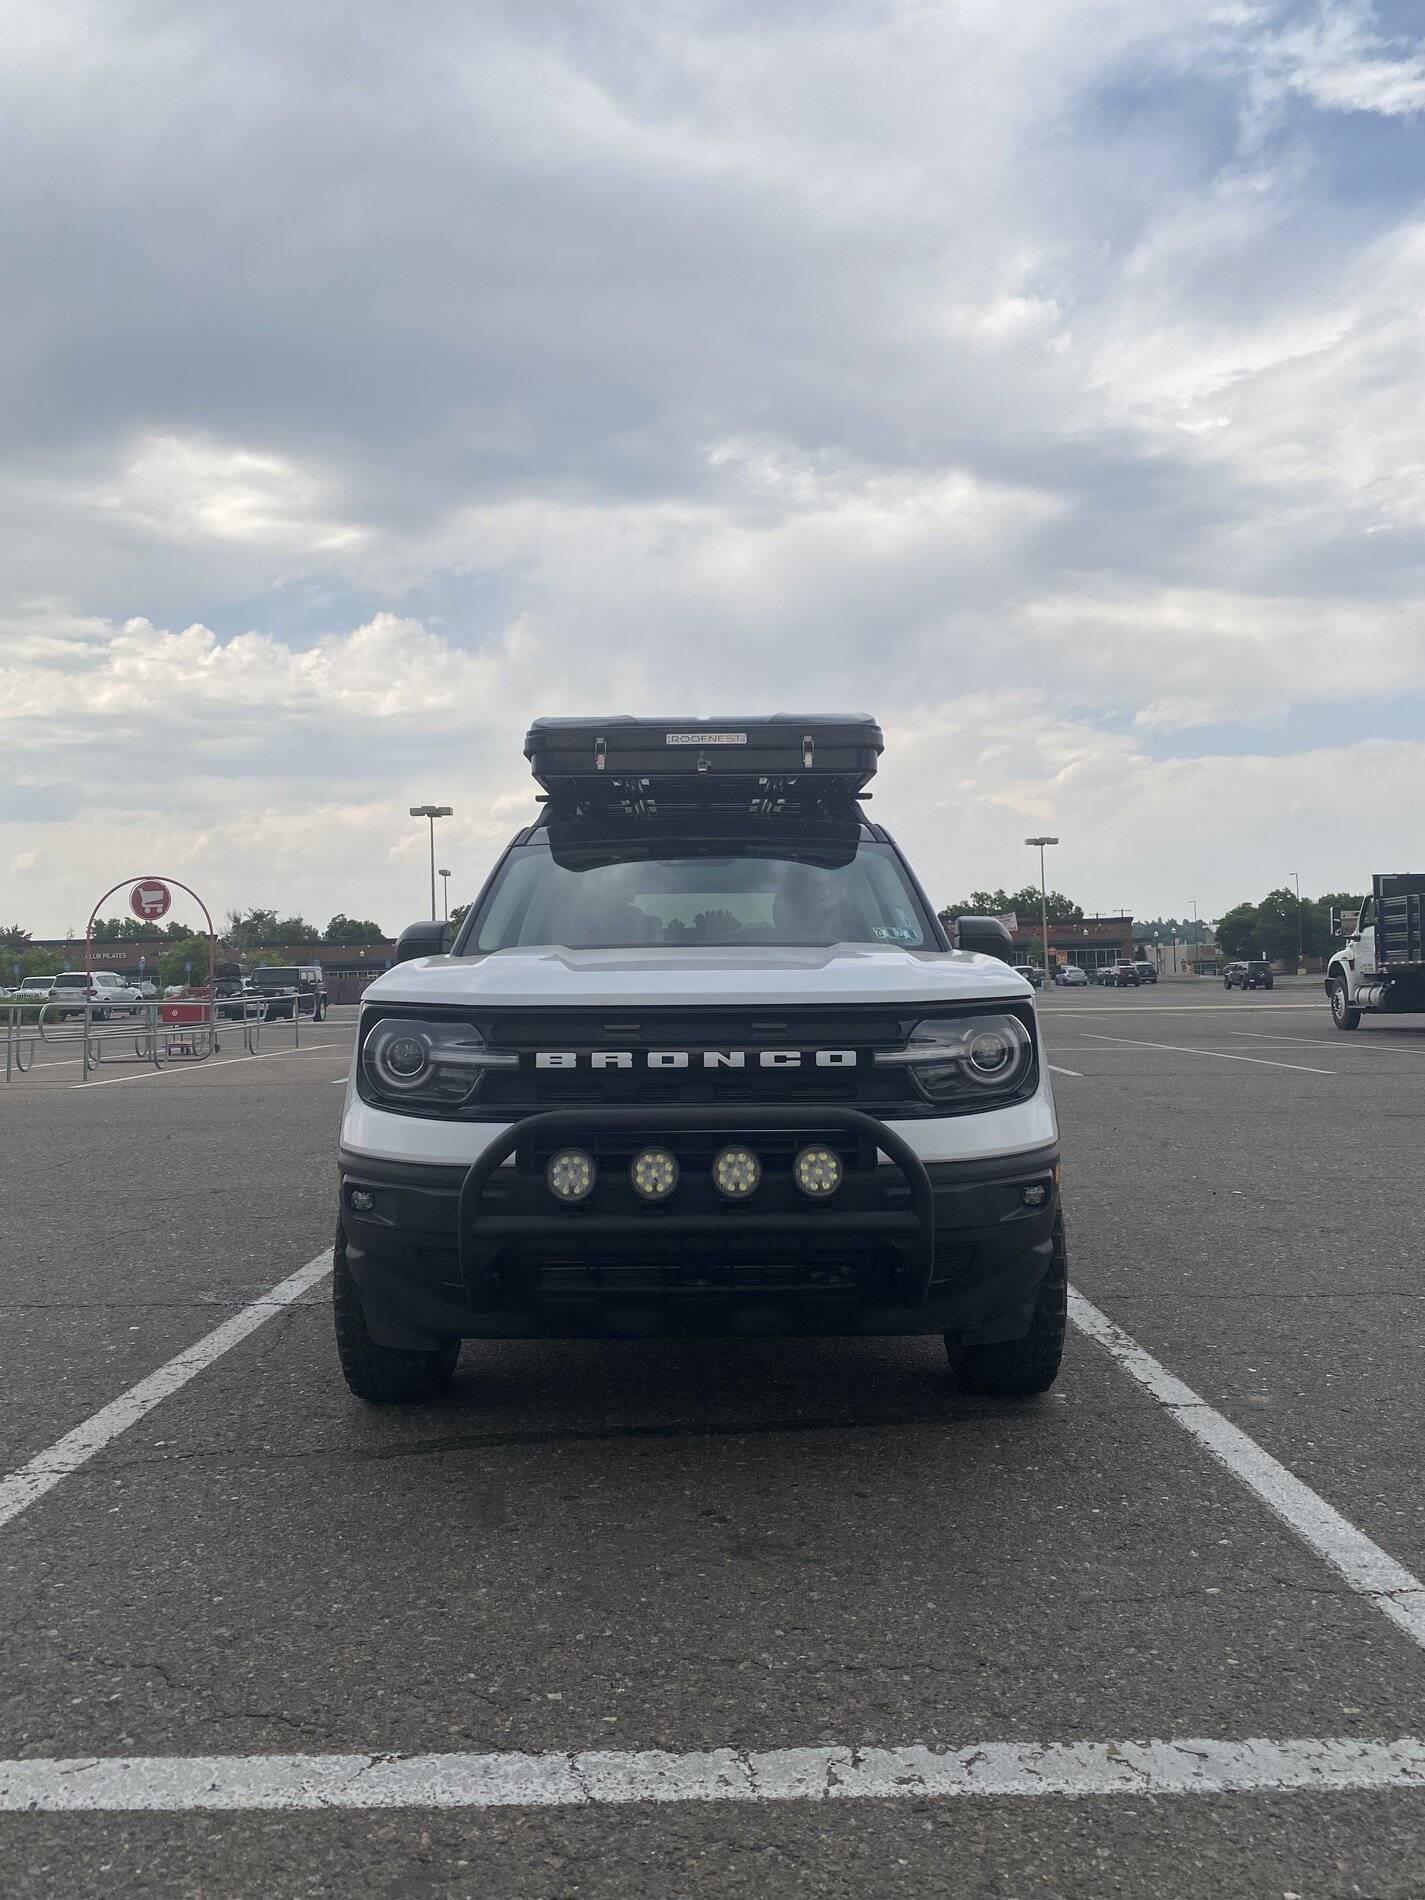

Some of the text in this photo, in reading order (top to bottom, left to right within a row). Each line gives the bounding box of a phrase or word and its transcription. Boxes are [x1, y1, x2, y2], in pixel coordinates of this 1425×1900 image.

[671, 735, 740, 743] ROOFNEST
[102, 952, 127, 960] PILATES
[536, 1051, 857, 1068] BRONCO
